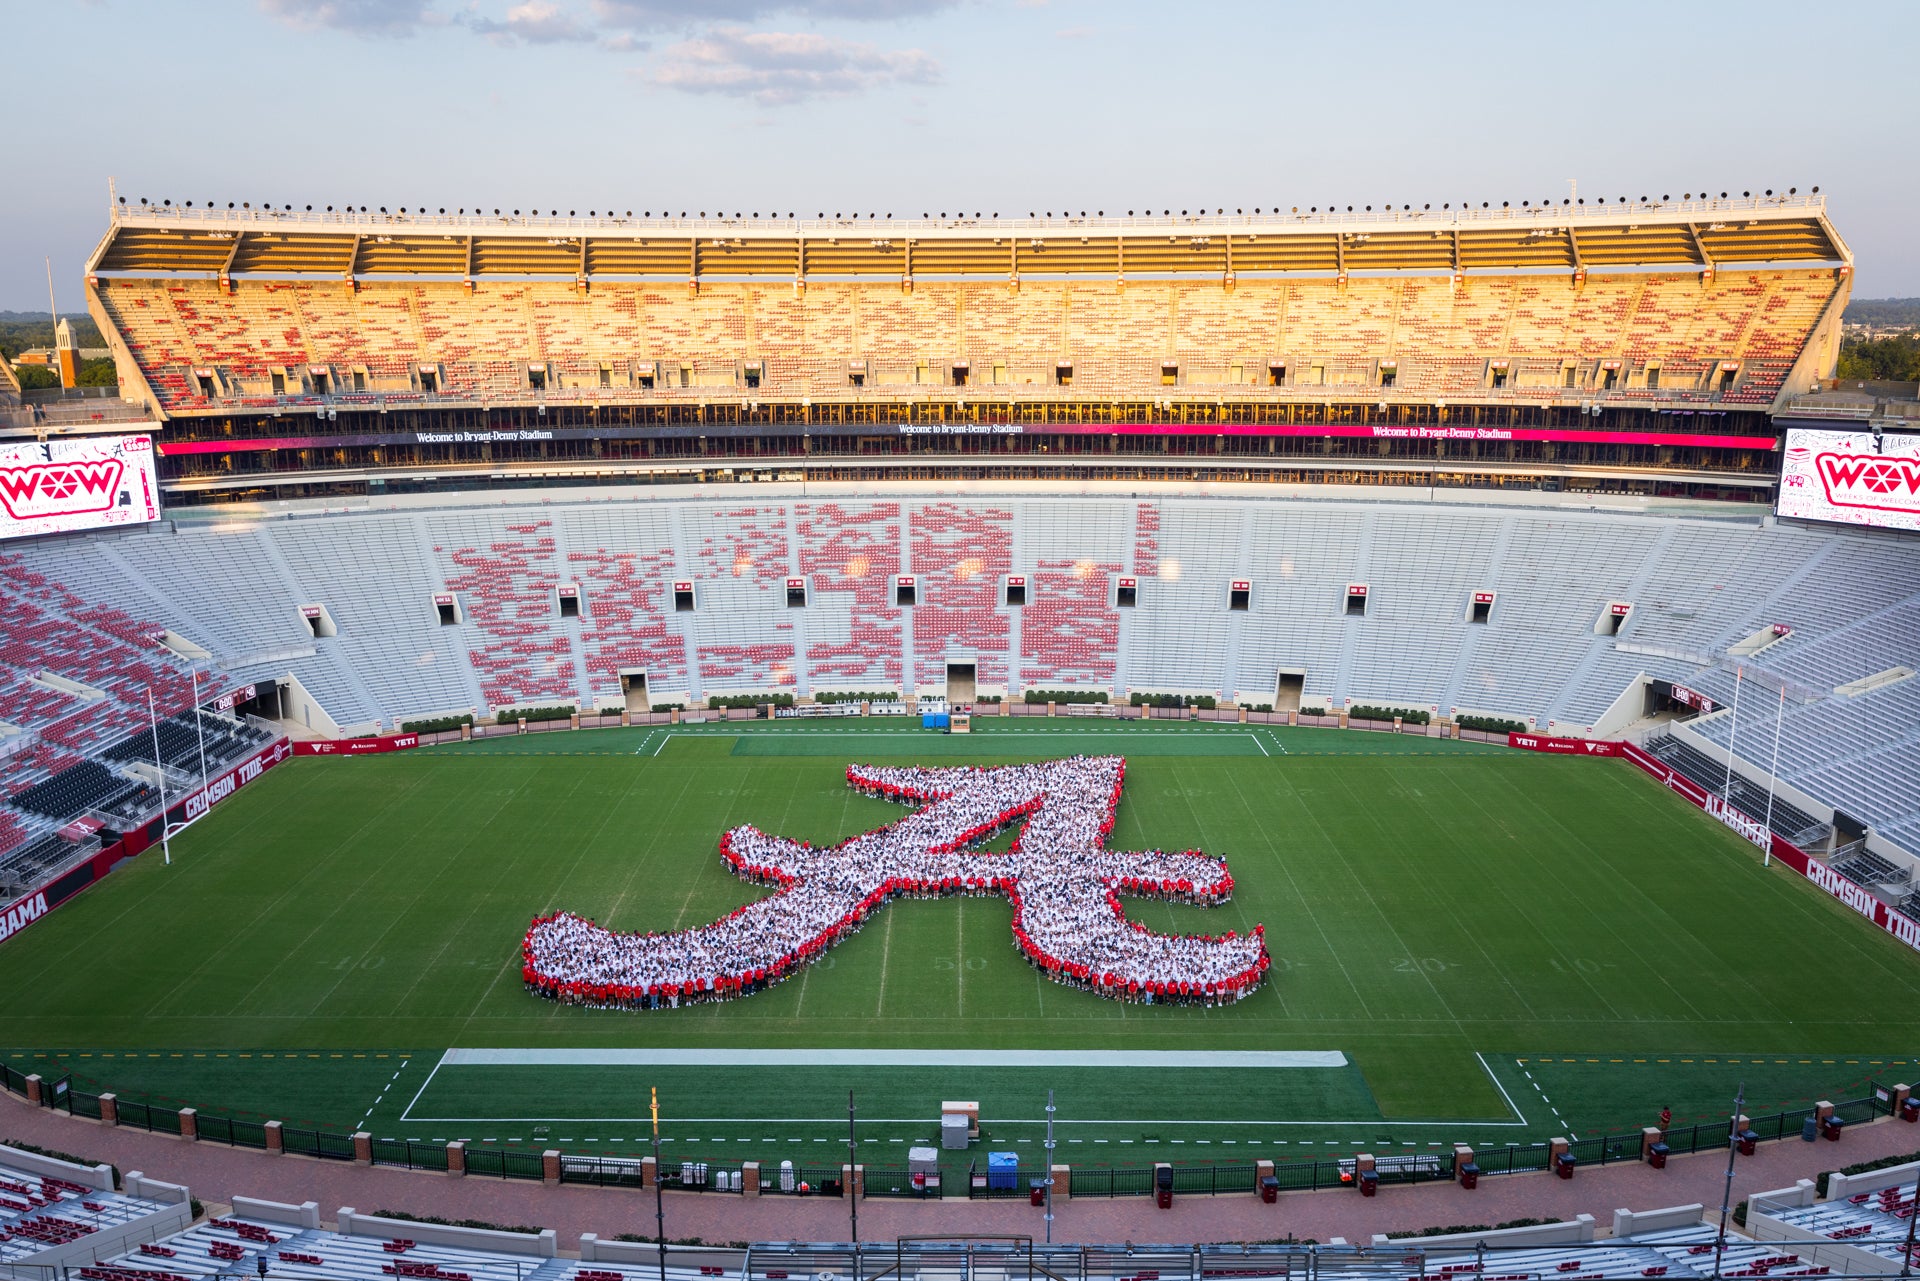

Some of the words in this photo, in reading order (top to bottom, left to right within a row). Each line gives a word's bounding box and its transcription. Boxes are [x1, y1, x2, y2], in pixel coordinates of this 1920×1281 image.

[899, 424, 932, 434] Welcome
[933, 425, 940, 433] to
[941, 424, 991, 434] Bryant-Denny
[992, 424, 1023, 433] Stadium
[1372, 426, 1409, 437] Welcome
[1410, 427, 1418, 437] to
[1419, 427, 1476, 438] Bryant-Denny
[1476, 428, 1512, 439] Stadium
[416, 432, 453, 443] Welcome
[454, 433, 463, 442] to
[464, 430, 518, 442] Bryant-Denny
[519, 430, 553, 440] Stadium
[394, 737, 415, 747] YETI
[1515, 737, 1538, 748] YETI
[185, 773, 236, 819] CRIMSON
[238, 755, 264, 785] TIDE
[1703, 793, 1767, 849] ALABAMA
[1806, 858, 1878, 921] CRIMSON
[934, 956, 988, 971] 50
[1388, 957, 1447, 972] 20
